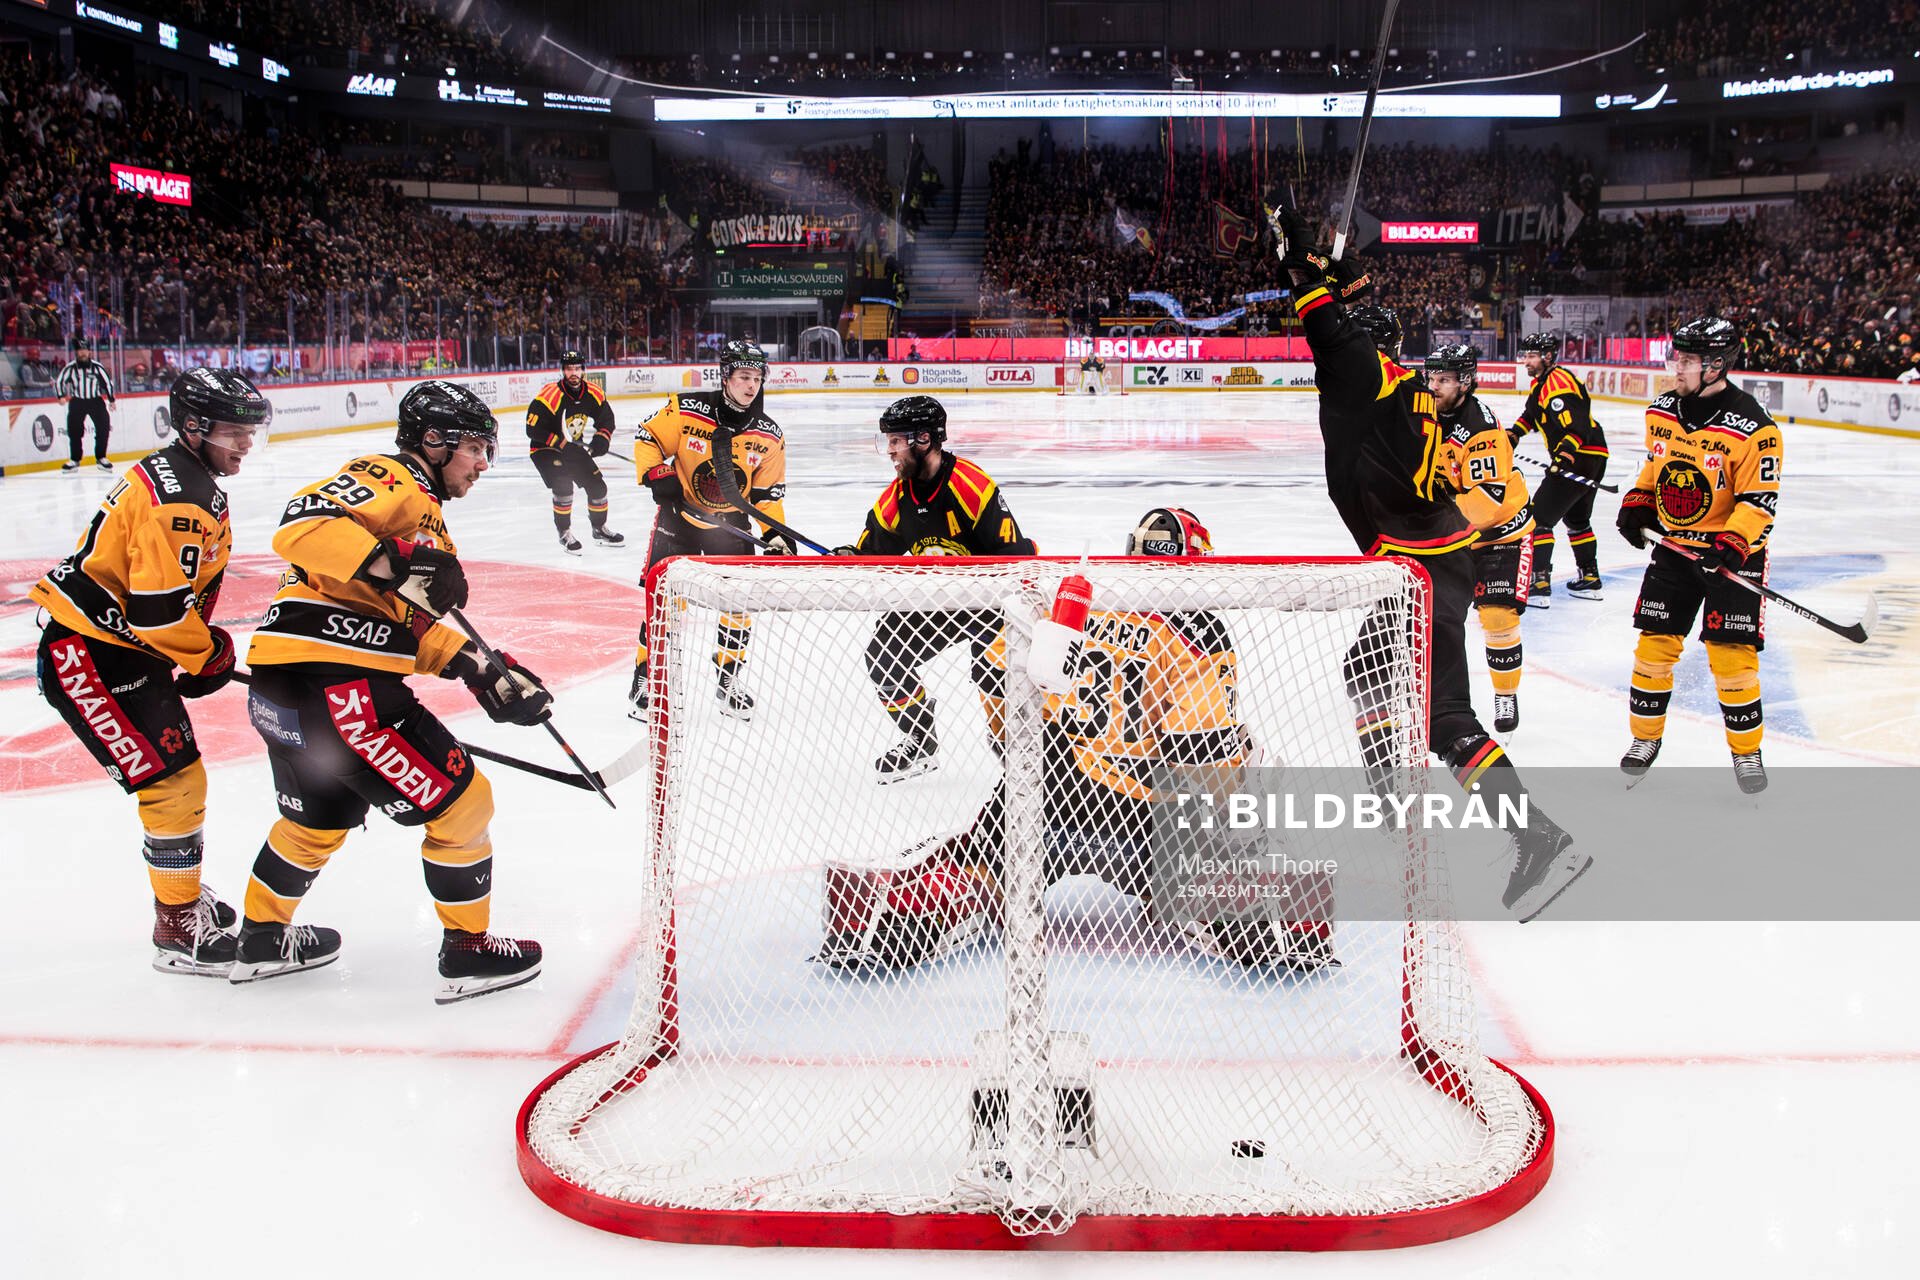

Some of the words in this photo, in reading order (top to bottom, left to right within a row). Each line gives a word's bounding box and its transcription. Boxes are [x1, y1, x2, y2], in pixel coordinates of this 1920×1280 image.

[543, 91, 566, 102] HEDIN
[567, 94, 612, 106] AUTOMOTIVE
[976, 98, 1006, 109] mest
[1010, 97, 1060, 109] anlitade
[1227, 98, 1241, 109] 10
[768, 213, 804, 243] BOYS
[1388, 225, 1476, 240] BILBOLAGET
[988, 369, 1032, 382] JULA
[1183, 369, 1202, 381] XL
[1230, 366, 1256, 376] EURO
[922, 375, 968, 385] Borgestad
[680, 398, 711, 415] SSAB
[757, 418, 783, 440] SSAB
[1722, 411, 1758, 433] SSAB
[690, 425, 714, 441] LKAB
[348, 459, 403, 493] BDX
[1470, 455, 1498, 482] 24
[1715, 469, 1727, 491] A
[317, 472, 377, 508] 29
[947, 510, 962, 537] A
[999, 517, 1017, 543] 41
[920, 536, 939, 546] 1912
[1147, 539, 1177, 554] LKAB
[178, 543, 202, 582] 9
[1487, 579, 1510, 587] Luleå
[1487, 587, 1515, 595] Energi
[1641, 607, 1670, 619] Energi
[1642, 599, 1665, 611] Luleå
[1775, 597, 1819, 623] BAUER
[1724, 621, 1756, 632] Energi
[1725, 613, 1752, 623] Luleå
[321, 613, 393, 647] SSAB
[1062, 638, 1084, 680] SHL
[111, 675, 149, 695] BAUER
[1060, 649, 1151, 745] 31
[340, 719, 442, 808] NÅIDEN
